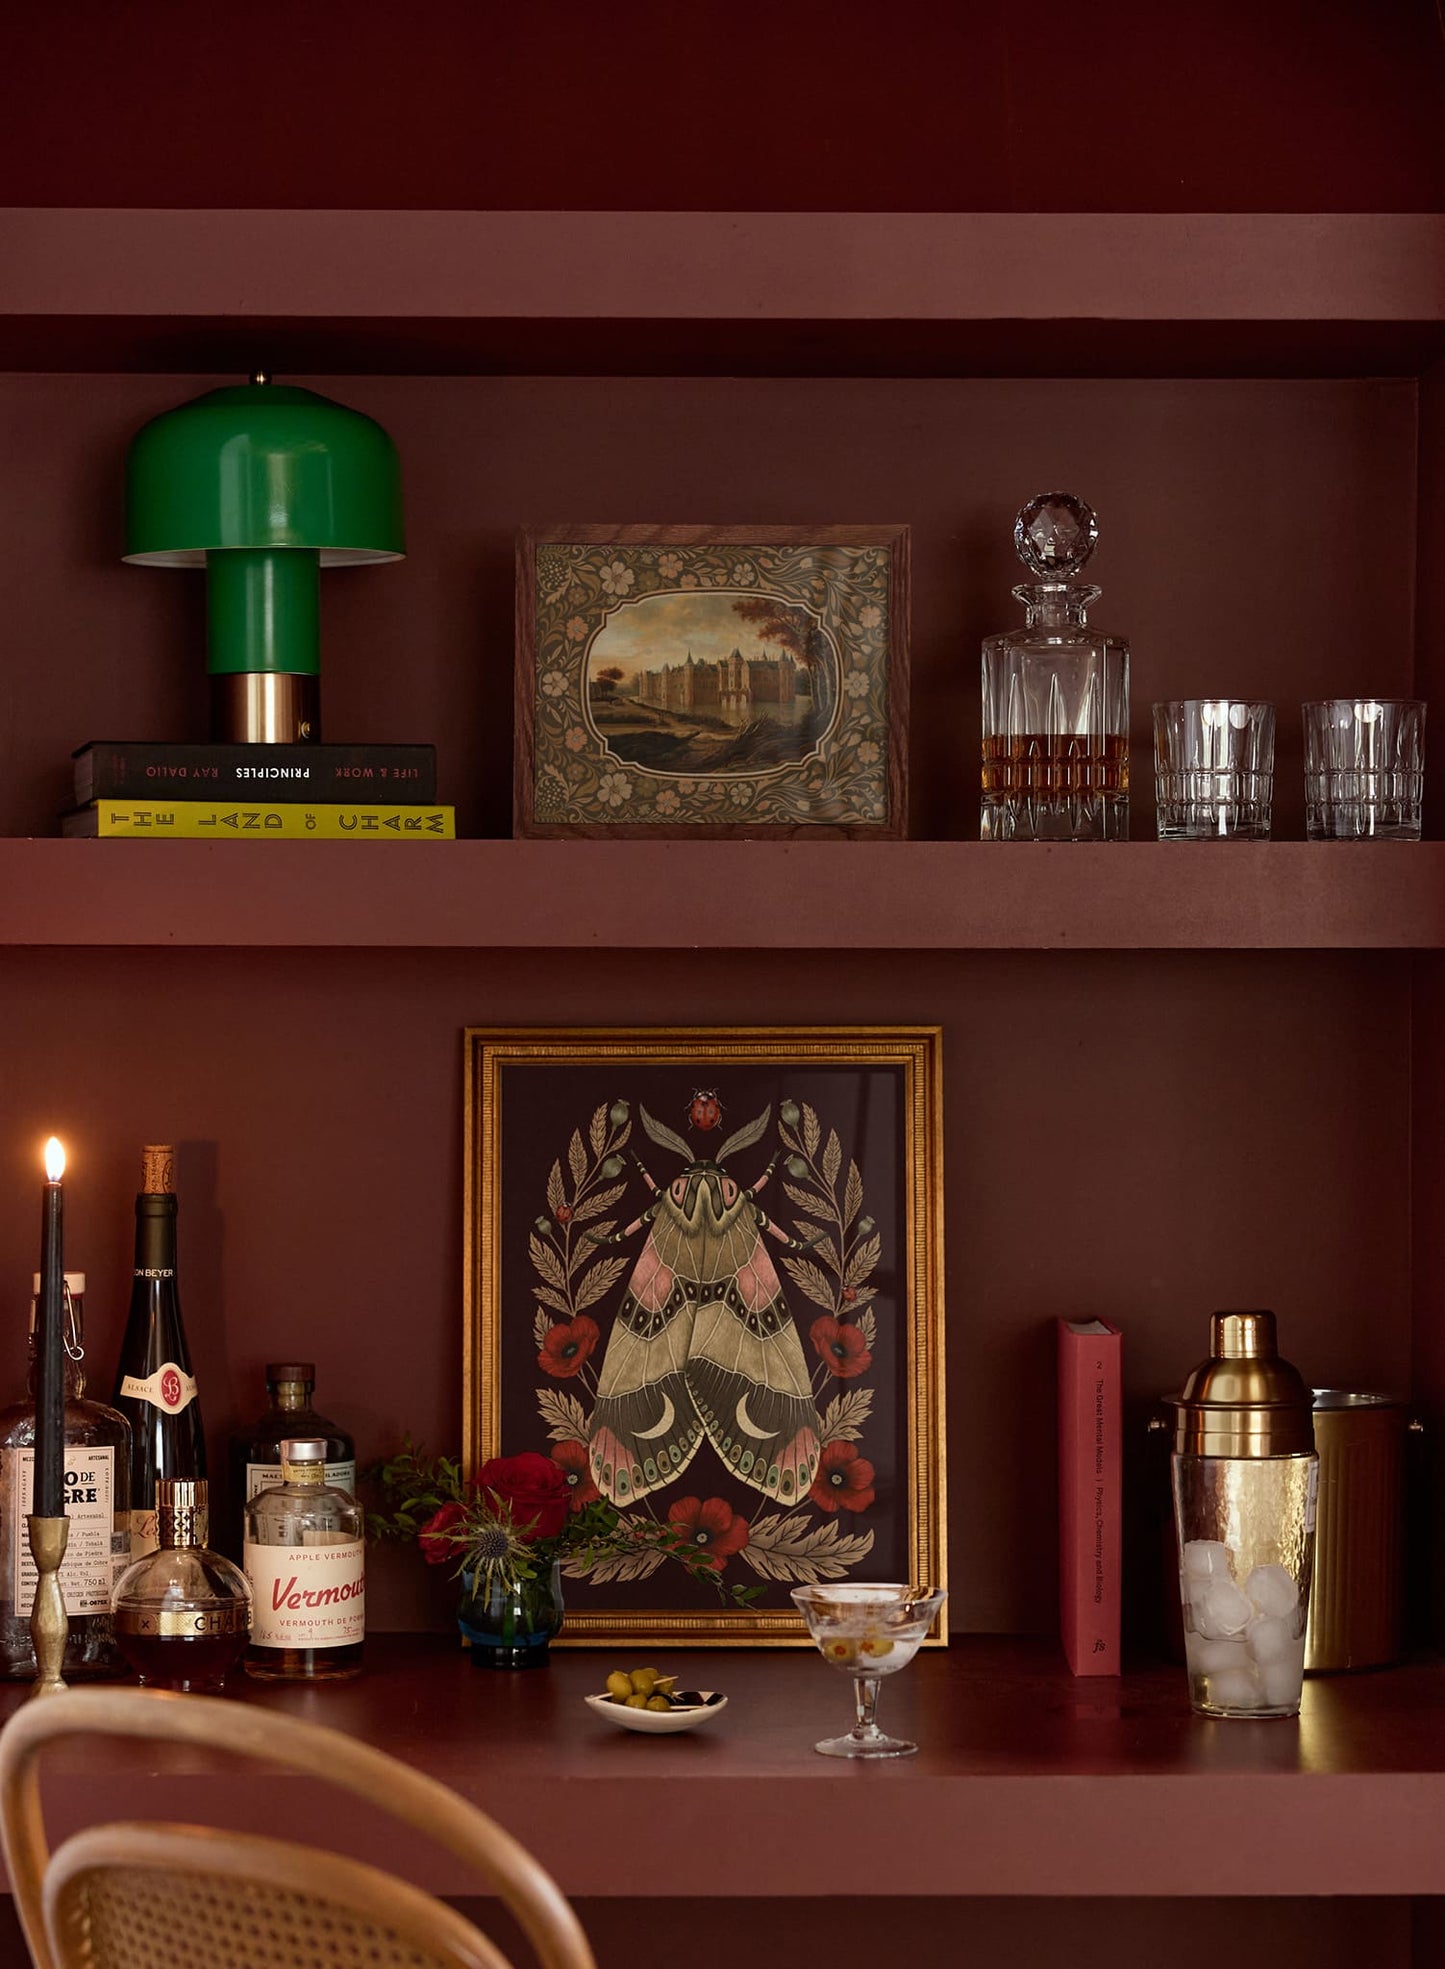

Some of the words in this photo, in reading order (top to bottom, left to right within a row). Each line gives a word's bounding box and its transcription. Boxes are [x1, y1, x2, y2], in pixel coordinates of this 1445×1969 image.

[145, 766, 189, 779] DALIO
[193, 766, 220, 779] RAY
[235, 767, 311, 780] PRINCIPLES
[336, 766, 375, 779] WORK
[392, 768, 420, 779] LIFE
[110, 811, 175, 827] THE
[197, 812, 283, 830] LAND
[304, 813, 317, 831] OF
[338, 813, 445, 834] CHARM
[145, 1268, 174, 1278] BEYER
[1095, 1360, 1103, 1370] 2
[1095, 1380, 1104, 1393] The
[1095, 1395, 1104, 1416] Great
[1095, 1417, 1104, 1444] Mental
[1095, 1445, 1104, 1474] Models
[80, 1471, 96, 1483] DE
[64, 1487, 97, 1505] GRE
[1094, 1520, 1104, 1558] Chemistry
[1095, 1559, 1104, 1576] and
[84, 1578, 98, 1586] 750
[1094, 1577, 1103, 1604] Biology
[279, 1618, 334, 1628] VERMOUTH
[336, 1617, 347, 1626] DE
